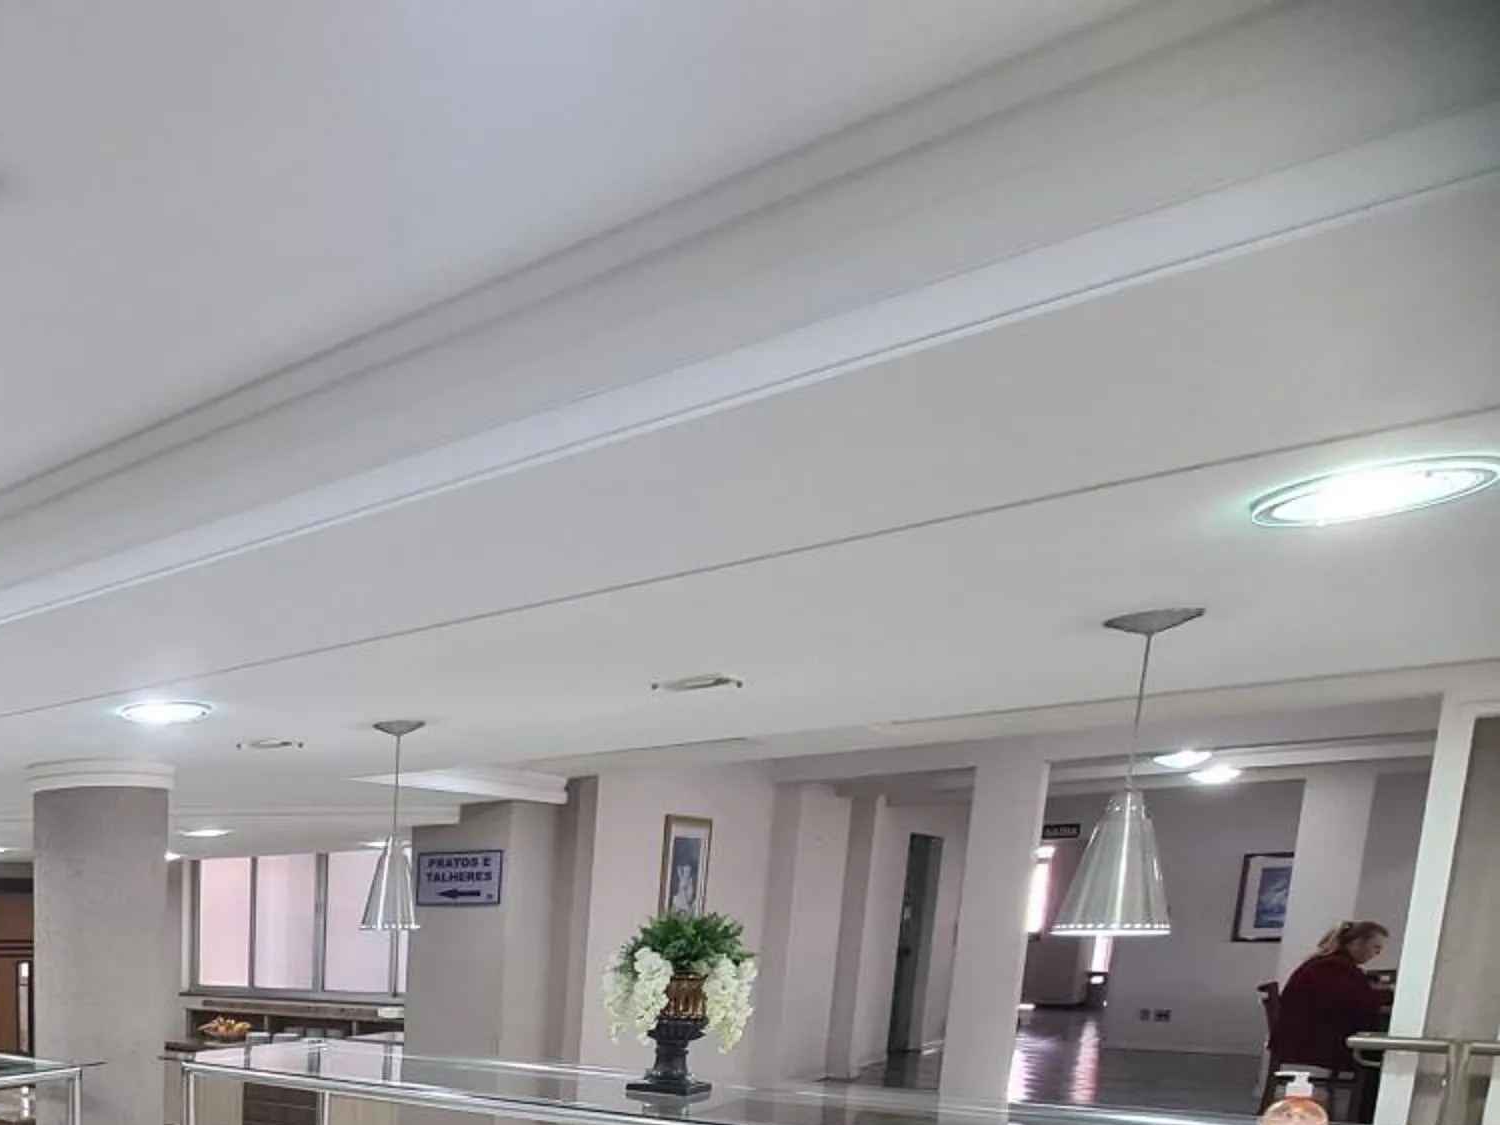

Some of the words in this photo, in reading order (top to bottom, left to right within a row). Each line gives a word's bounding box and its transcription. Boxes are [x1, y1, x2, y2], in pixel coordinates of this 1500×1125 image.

[428, 856, 478, 868] PRATOS
[483, 857, 491, 867] E
[426, 871, 492, 882] TALHERES
